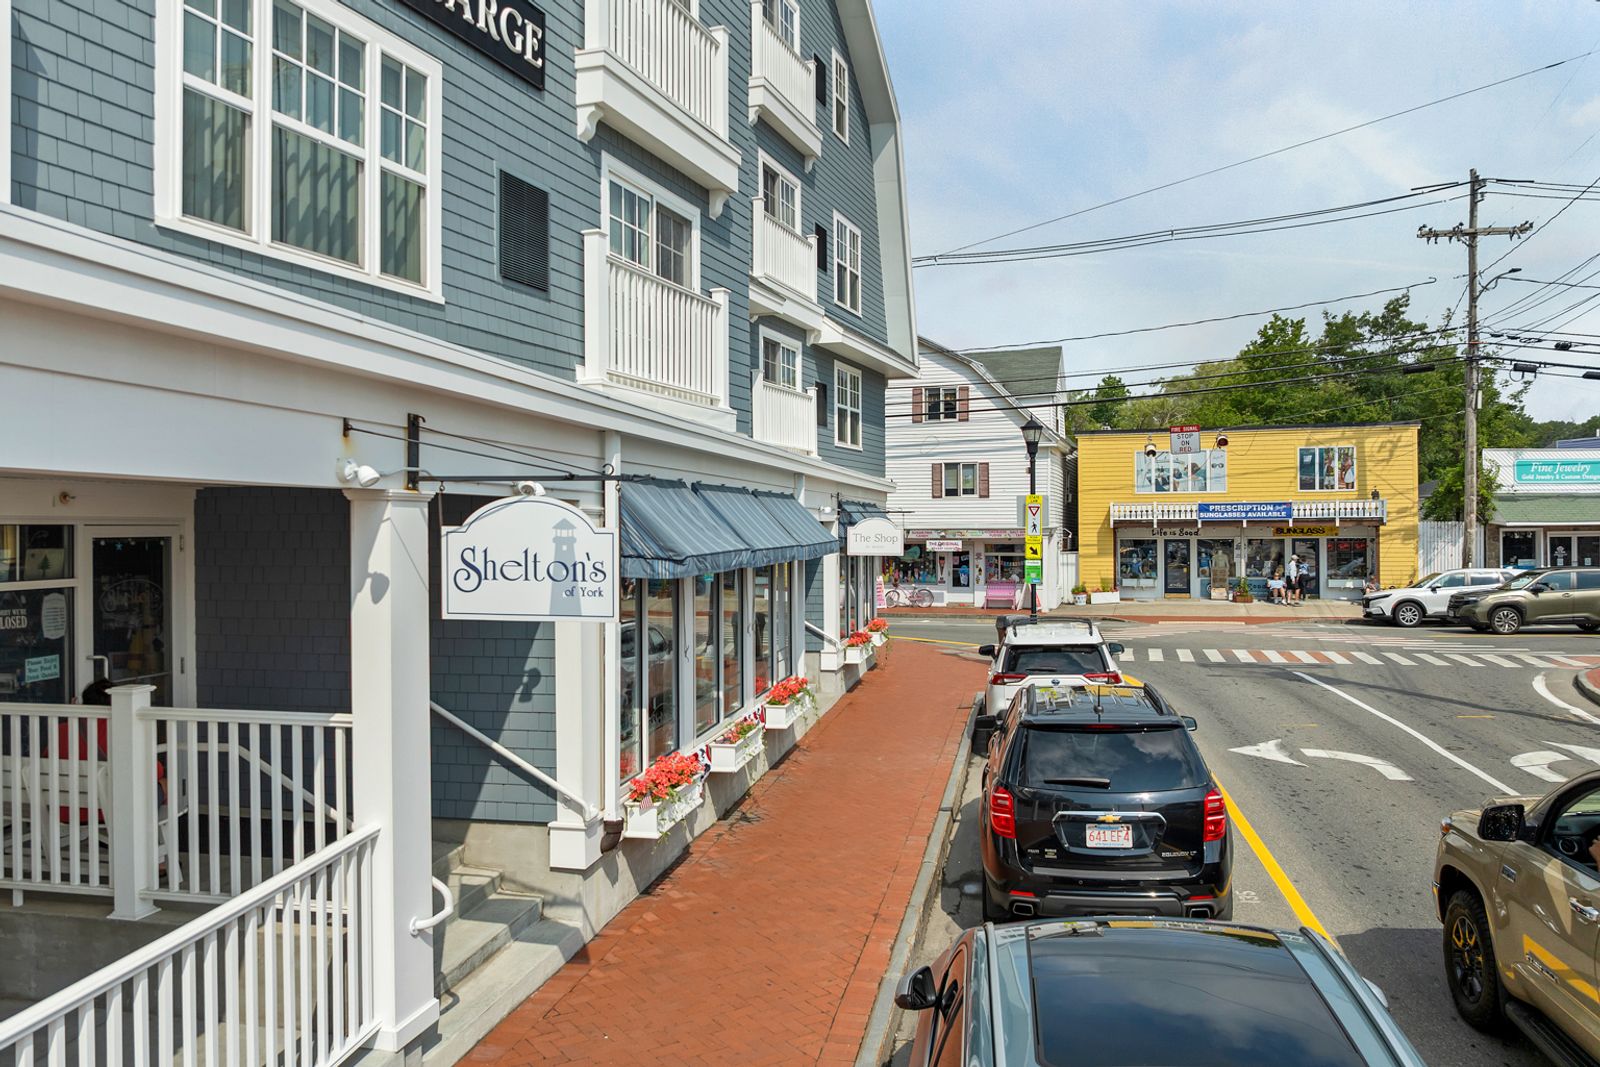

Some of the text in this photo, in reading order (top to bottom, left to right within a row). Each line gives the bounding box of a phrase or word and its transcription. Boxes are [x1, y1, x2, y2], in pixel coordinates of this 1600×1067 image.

[1531, 462, 1591, 474] Fine Jewelry
[1209, 504, 1274, 512] PRESCRIPTION
[1151, 528, 1168, 536] Life
[1169, 527, 1177, 536] is
[1275, 527, 1326, 535] SUNGLASS
[852, 533, 898, 545] The Shop
[453, 545, 608, 593] Shelton's
[564, 586, 605, 598] of York
[1088, 830, 1130, 842] 641 EF4
